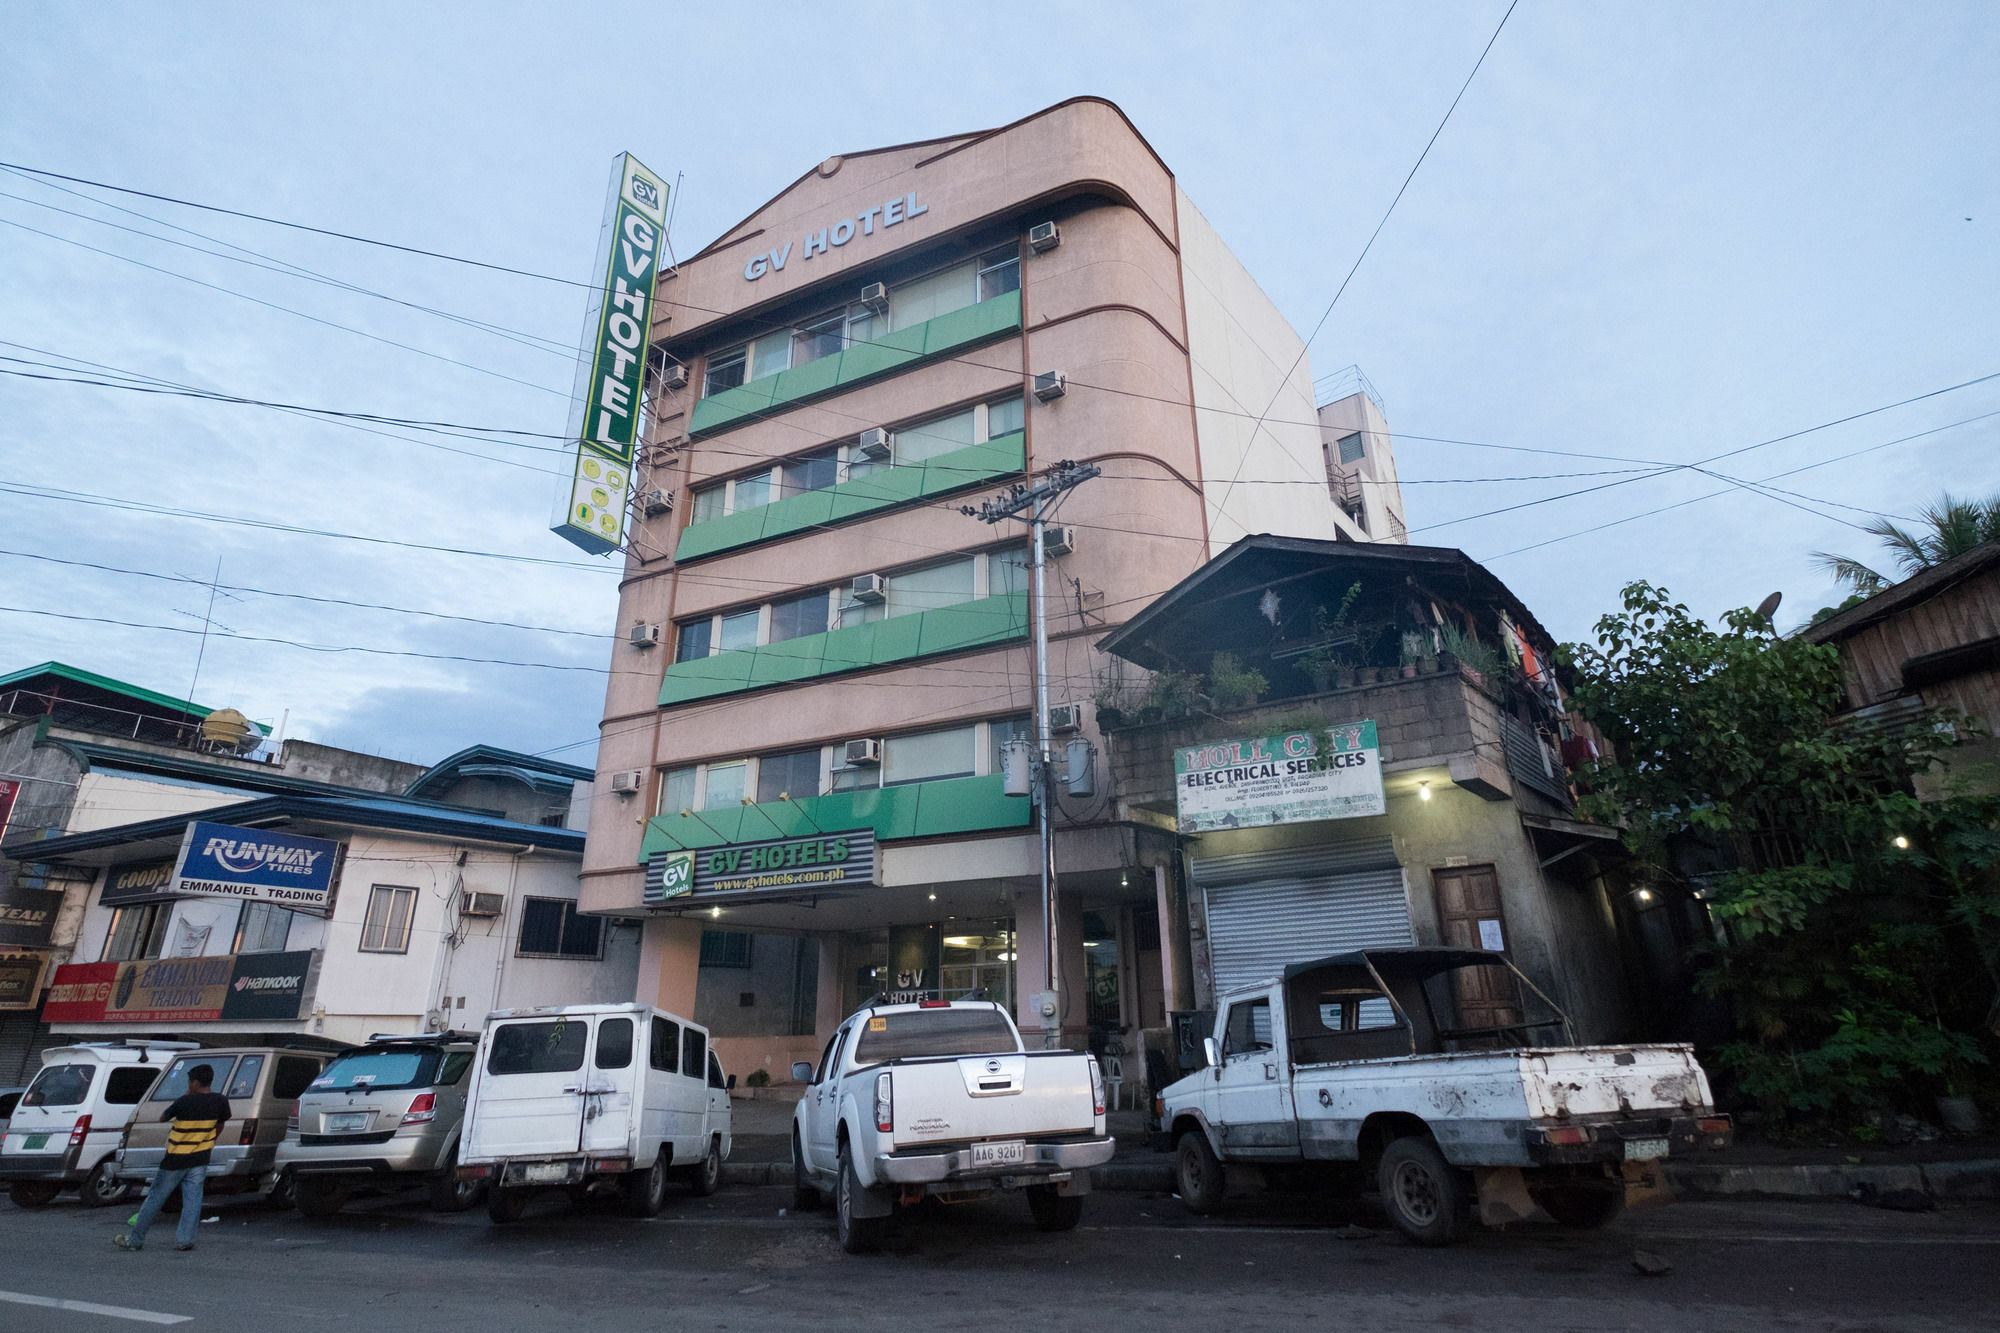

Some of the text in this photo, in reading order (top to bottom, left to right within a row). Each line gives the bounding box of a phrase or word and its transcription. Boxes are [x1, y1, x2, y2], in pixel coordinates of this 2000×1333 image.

[633, 180, 657, 202] GV
[621, 213, 654, 279] GV
[743, 191, 929, 281] GV HOTEL
[596, 276, 646, 453] HOTEL
[1187, 763, 1280, 787] ELECTRICAL
[202, 837, 323, 871] RUNWAY
[708, 838, 849, 874] GV HOTELS
[268, 863, 313, 875] TIRES
[663, 862, 690, 887] GV
[713, 868, 845, 890] www.gvhotels.com.ph
[179, 880, 324, 901] EMMANUEL TRADING
[666, 883, 689, 898] Hotels
[139, 959, 231, 988] EMMANUEL
[148, 989, 207, 1007] TRADING
[975, 1144, 1022, 1161] AAG 9201
